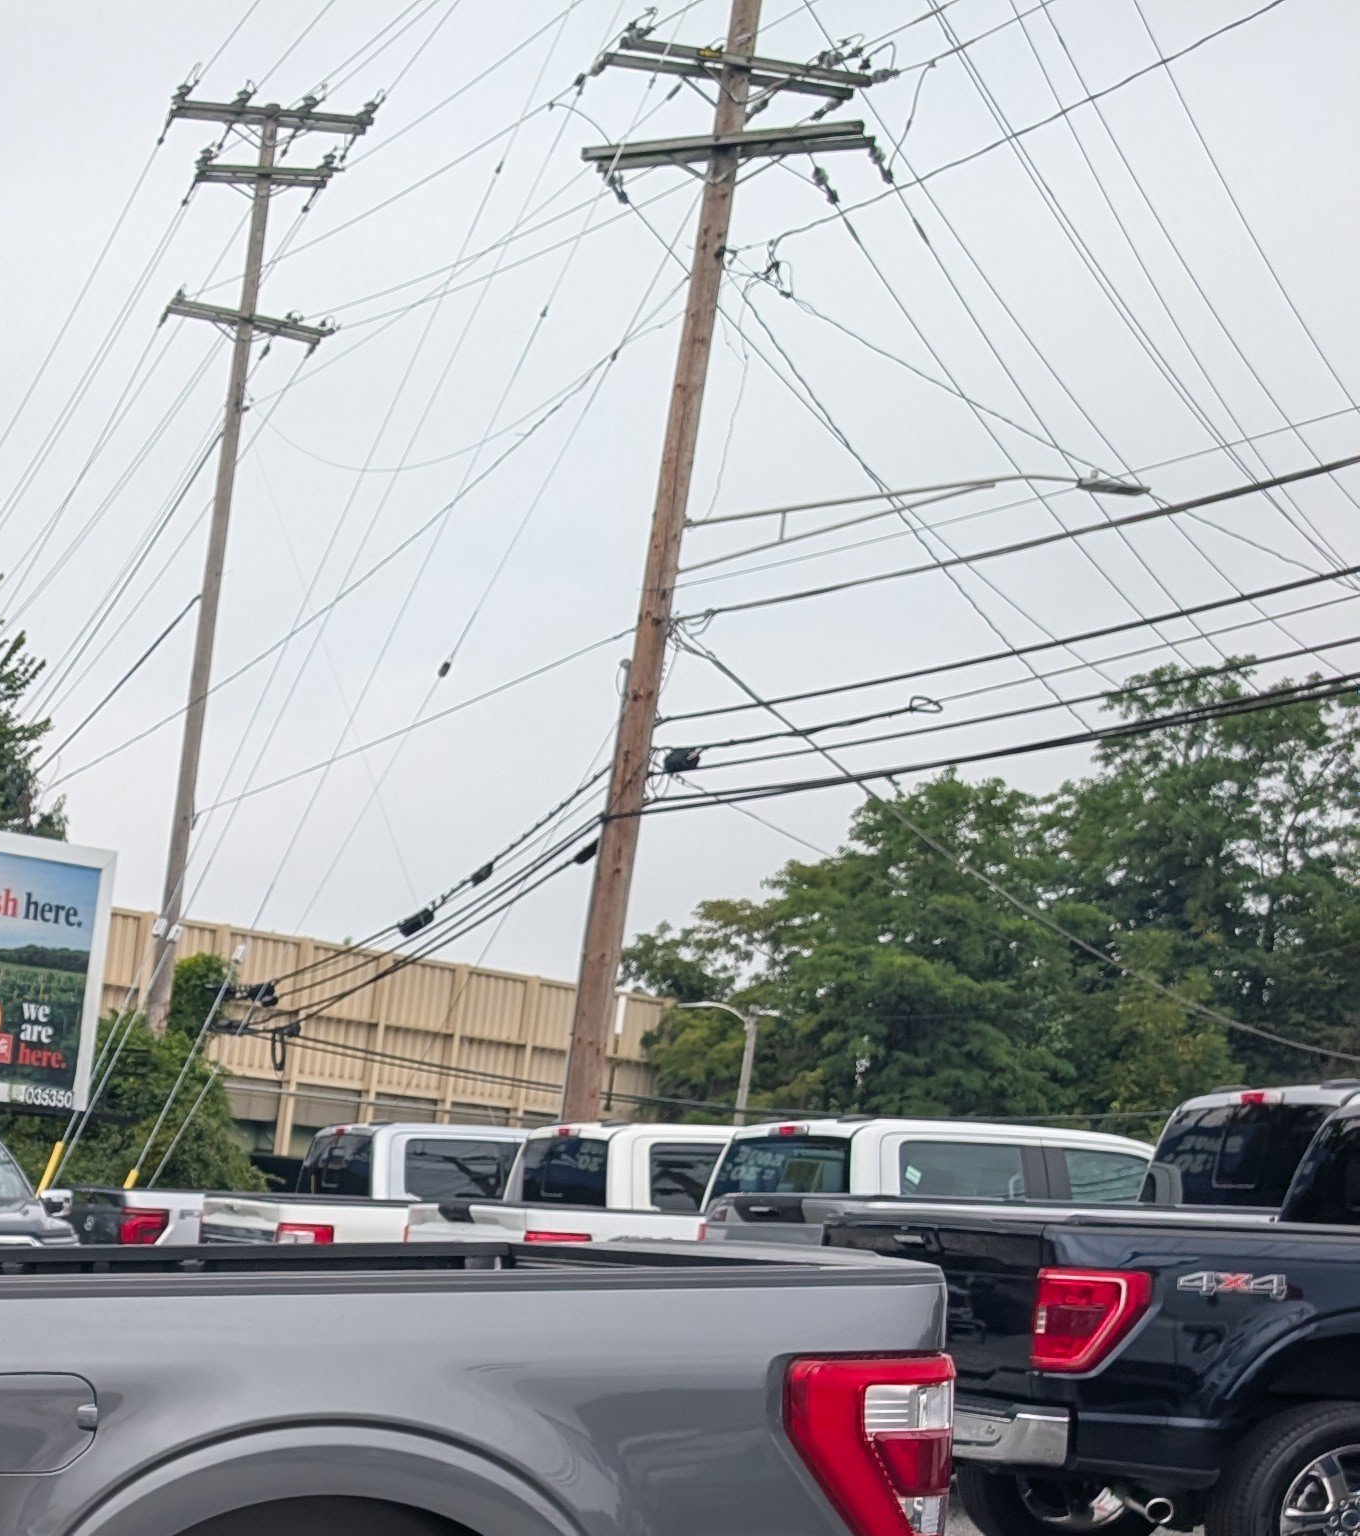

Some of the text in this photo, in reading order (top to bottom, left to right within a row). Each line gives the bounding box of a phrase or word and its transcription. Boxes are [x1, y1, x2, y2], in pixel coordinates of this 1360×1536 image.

[23, 891, 83, 929] here.
[22, 1001, 52, 1023] we
[19, 1021, 54, 1043] are
[17, 1041, 68, 1069] here.
